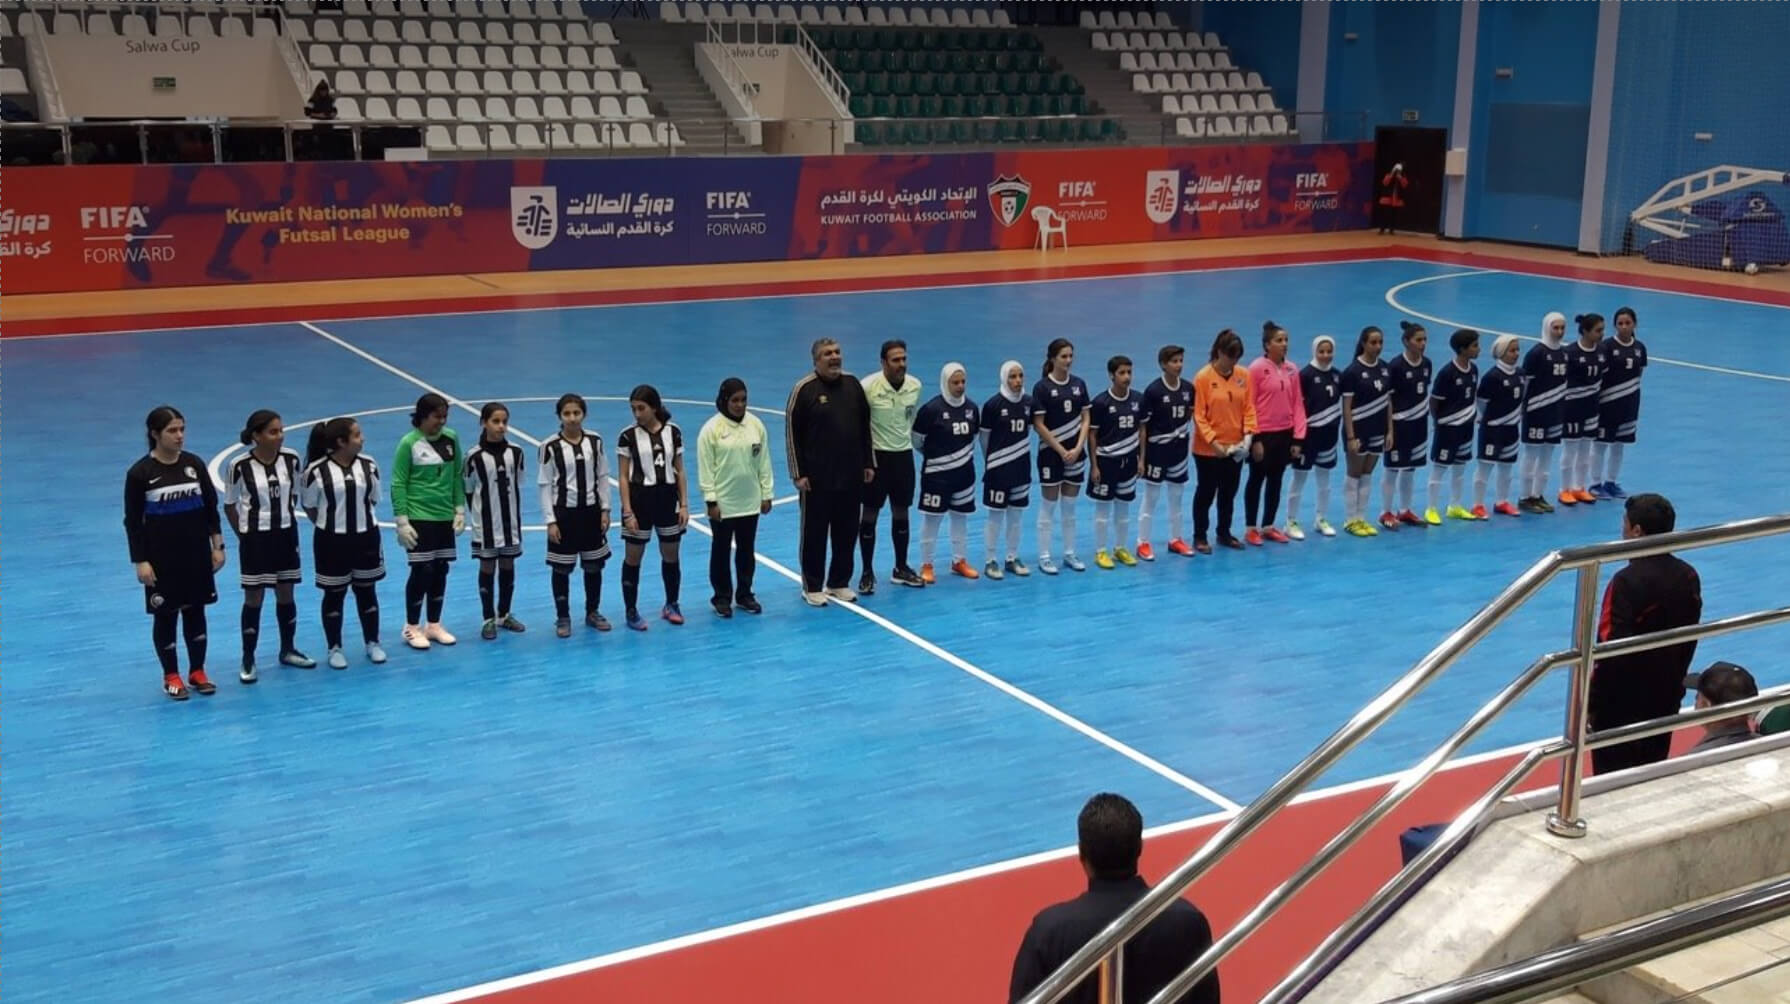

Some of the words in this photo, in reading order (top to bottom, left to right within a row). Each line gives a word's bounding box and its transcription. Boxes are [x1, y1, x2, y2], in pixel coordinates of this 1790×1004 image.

[126, 40, 168, 53] Salwa
[171, 39, 200, 54] Cup
[757, 46, 779, 59] Cup
[1184, 175, 1232, 194] الصالات
[1230, 175, 1262, 197] دوري
[1295, 172, 1328, 189] FIFA
[859, 189, 885, 206] لكرة
[888, 187, 937, 209] الكويتي
[1058, 182, 1095, 198] FIFA
[566, 192, 632, 215] الصالات
[632, 193, 675, 218] دوري
[706, 191, 750, 209] FIFA
[820, 190, 856, 210] القدم
[1294, 198, 1338, 211] FORWARD
[80, 206, 149, 229] FIFA
[226, 206, 293, 224] Kuwait
[299, 204, 377, 222] National
[381, 202, 464, 220] Women's
[820, 213, 860, 225] KUWAIT
[863, 212, 912, 224] FOOTBALL
[914, 210, 977, 222] ASSOCIATION
[279, 226, 337, 244] Futsal
[343, 226, 410, 244] League
[617, 220, 652, 239] القدم
[654, 220, 674, 236] كرة
[706, 221, 767, 237] FORWARD
[24, 240, 51, 259] كرة
[83, 246, 176, 265] FORWARD
[1587, 365, 1599, 377] 11
[1063, 399, 1073, 413] 9
[1171, 405, 1186, 419] 15
[952, 421, 970, 435] 20
[1010, 419, 1025, 433] 10
[1118, 415, 1135, 429] 22
[1567, 422, 1579, 434] 11
[654, 452, 665, 468] 4
[1147, 464, 1162, 479] 15
[922, 493, 941, 508] 20
[989, 489, 1006, 504] 10
